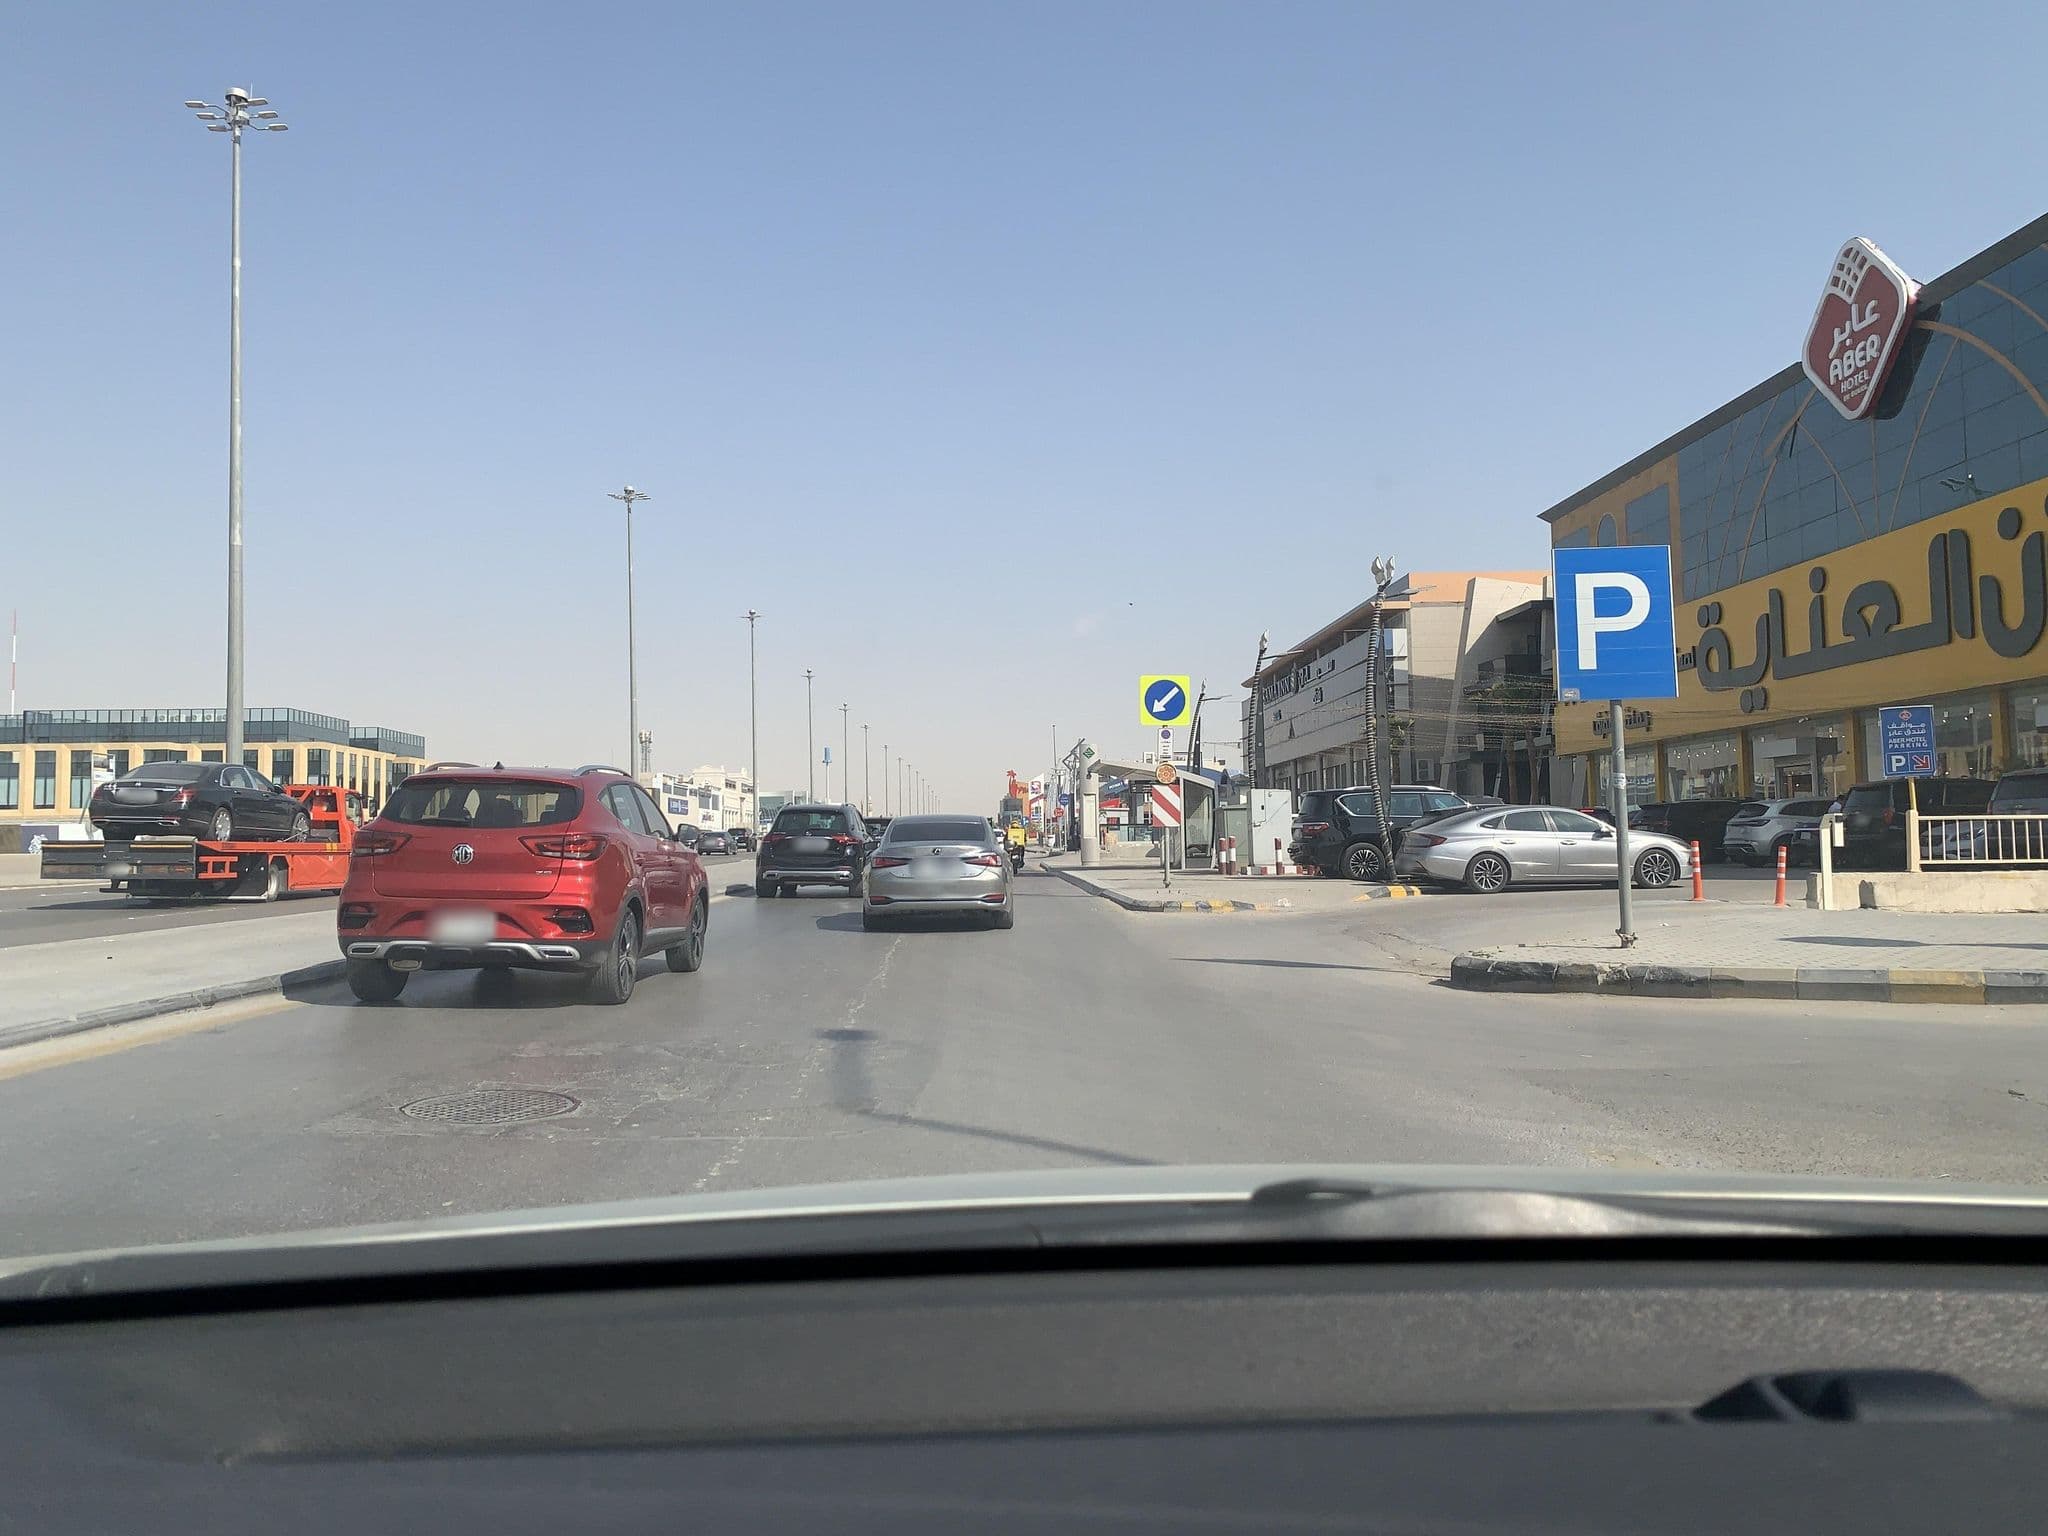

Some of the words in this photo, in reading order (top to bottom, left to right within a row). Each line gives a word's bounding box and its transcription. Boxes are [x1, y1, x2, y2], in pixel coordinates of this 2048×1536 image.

[1828, 299, 1880, 360] عابر
[1829, 334, 1880, 386] ABER
[1841, 369, 1869, 393] HOTEL
[1575, 571, 1651, 670] P
[1697, 528, 1975, 713] العناية
[1888, 729, 1903, 737] عابر
[1904, 728, 1926, 736] فندق
[1891, 755, 1906, 772] P
